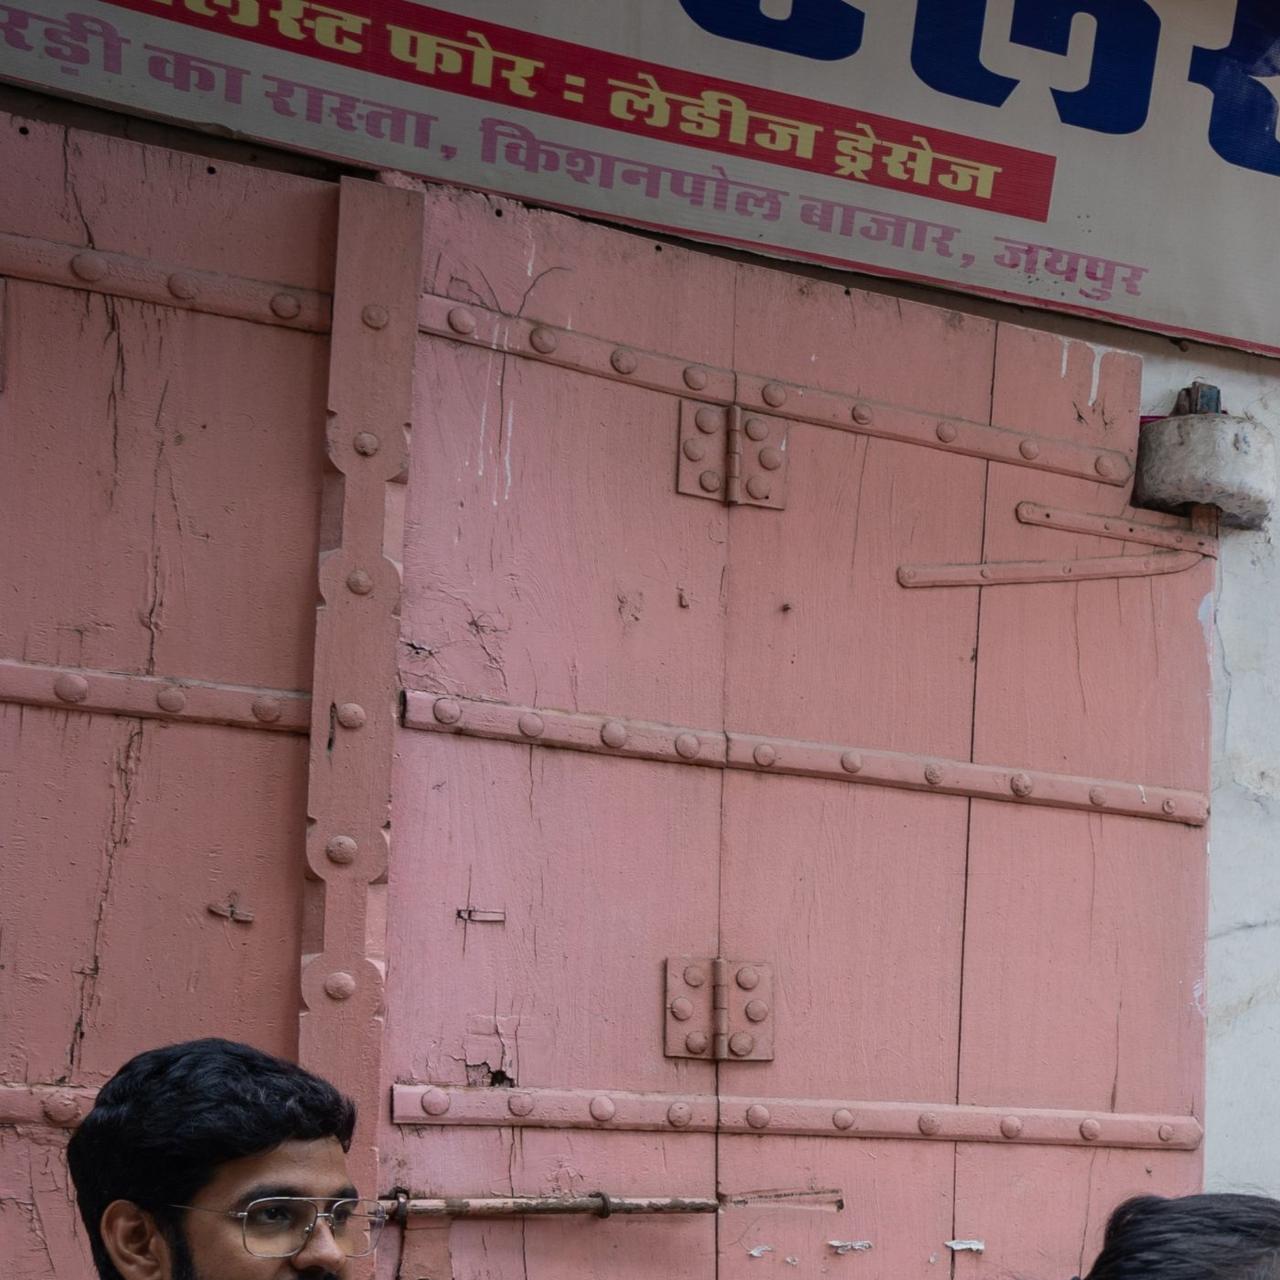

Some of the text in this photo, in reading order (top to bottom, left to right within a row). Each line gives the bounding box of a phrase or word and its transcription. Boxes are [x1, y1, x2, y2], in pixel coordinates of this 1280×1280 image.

[143, 43, 252, 105] का
[262, 73, 457, 161] रास्ता,
[480, 118, 787, 222] किशनपोल
[799, 193, 976, 268] बाजार,
[993, 235, 1149, 302] जयपुर
[386, 22, 547, 100] फोर
[607, 72, 824, 160] लेडीज
[834, 124, 1003, 200] ड्रेसेज
